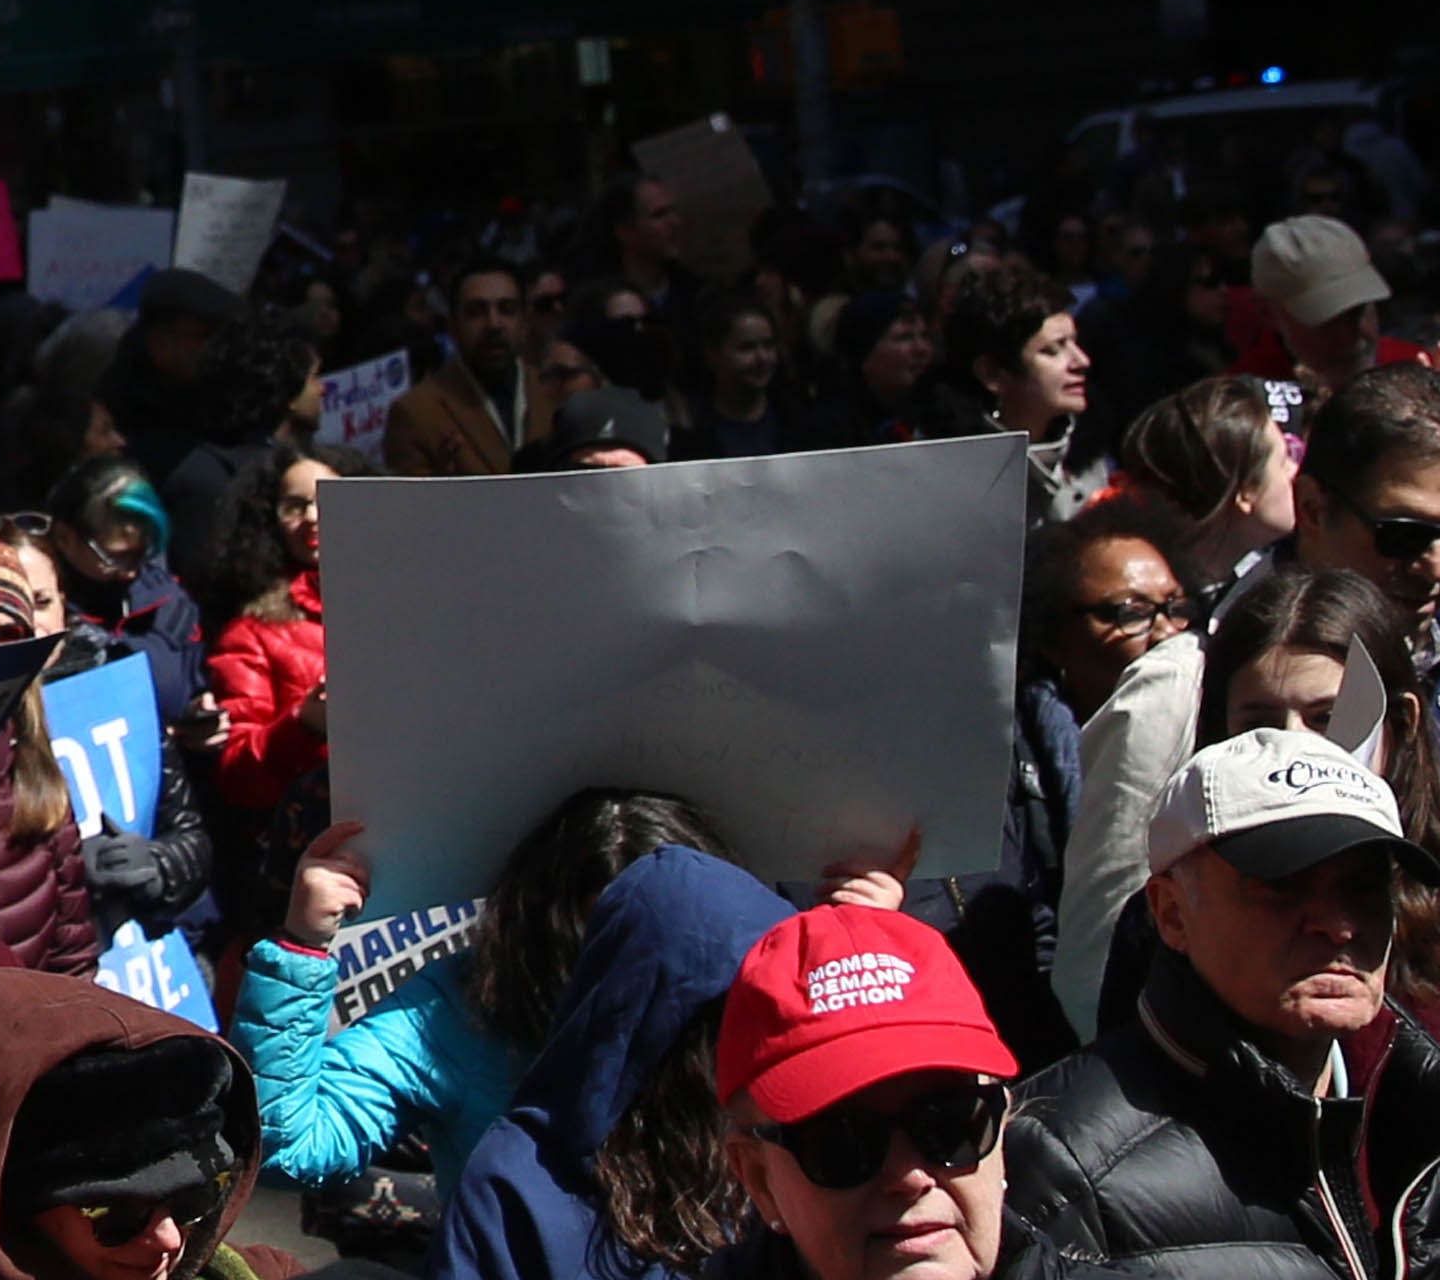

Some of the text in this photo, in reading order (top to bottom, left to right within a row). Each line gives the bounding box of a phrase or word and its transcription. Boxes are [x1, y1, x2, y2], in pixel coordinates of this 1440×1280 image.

[50, 717, 129, 841] OT
[1267, 760, 1382, 800] Cheers
[807, 952, 879, 985] MOMS
[809, 967, 912, 1000] DEMAND
[811, 984, 905, 1016] ACTION
